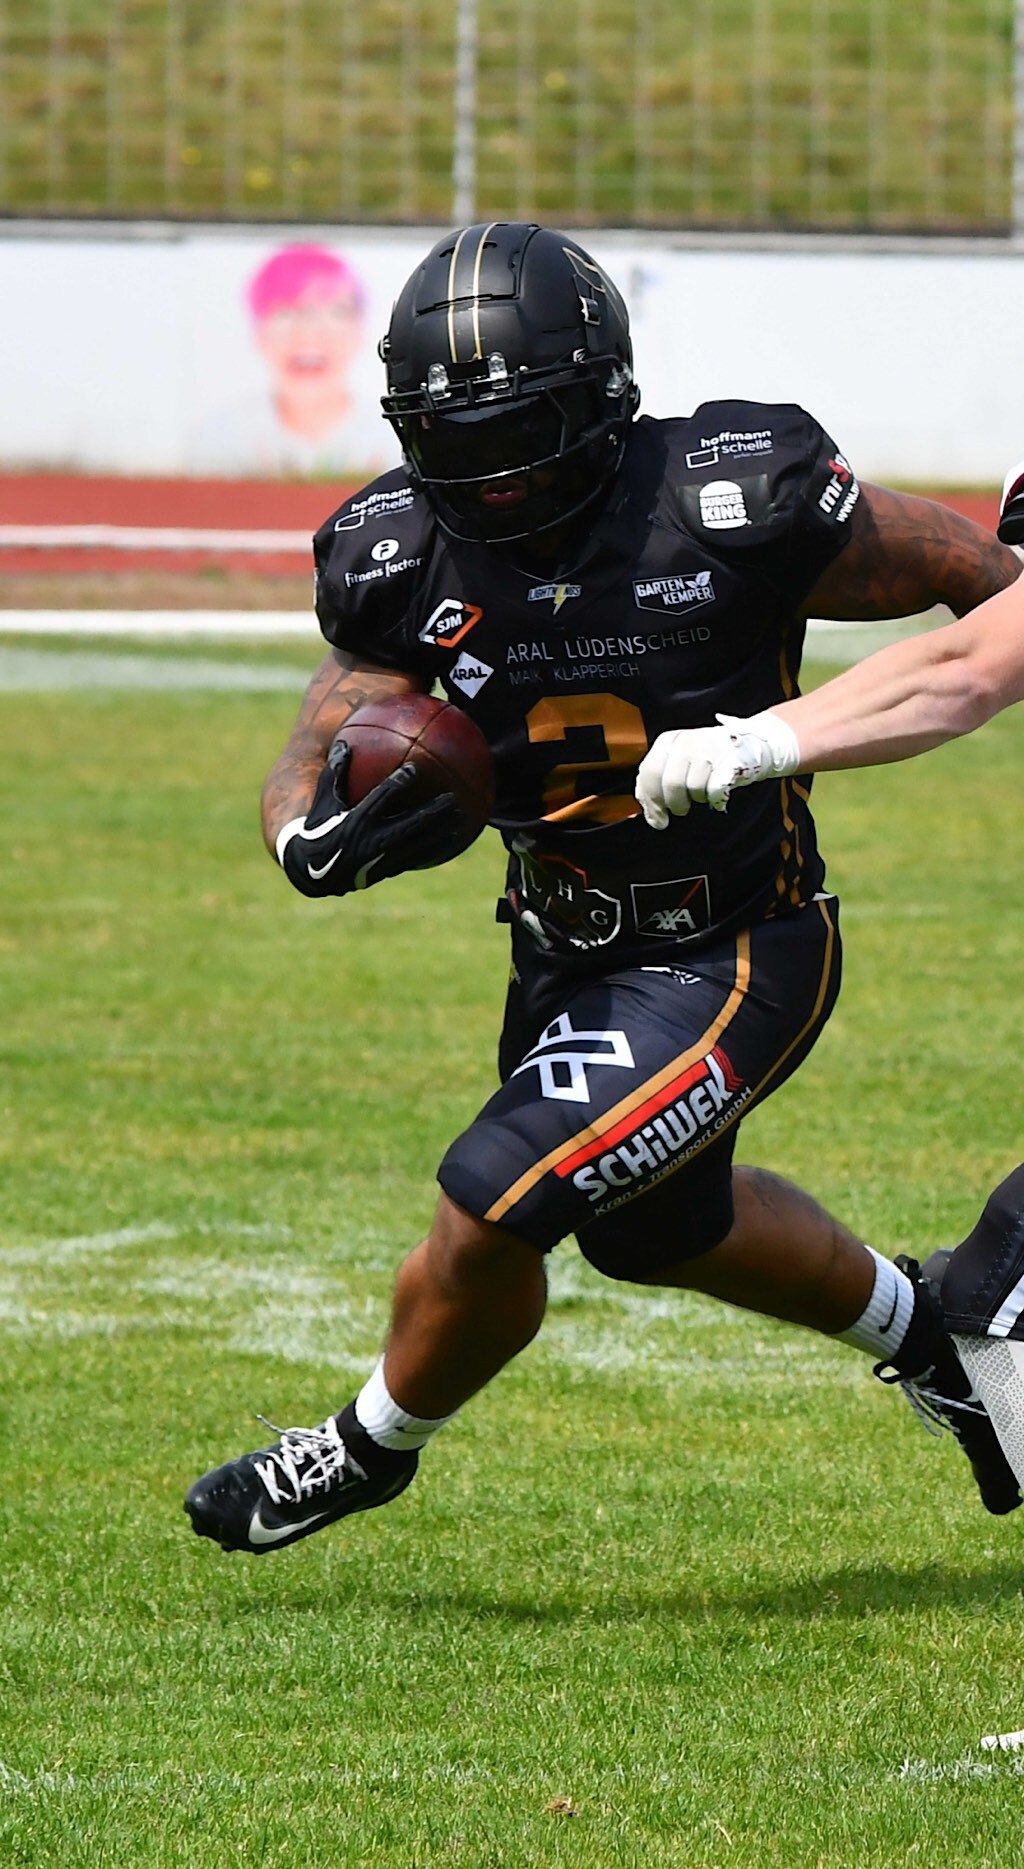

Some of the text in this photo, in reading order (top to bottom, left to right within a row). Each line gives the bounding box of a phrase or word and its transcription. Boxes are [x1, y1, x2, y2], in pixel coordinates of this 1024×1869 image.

[700, 430, 772, 448] hoffmann
[721, 439, 772, 454] schelle
[367, 496, 414, 516] schelle
[700, 493, 744, 508] BURGER
[701, 503, 747, 522] KING
[345, 558, 421, 588] fitness factor
[636, 578, 685, 597] GARTEN
[662, 586, 713, 606] KEMPER
[436, 613, 462, 633] SJM
[506, 627, 711, 664] ARAL LÜDENSCHEID
[452, 666, 488, 680] ARAL
[553, 663, 640, 681] KLAPPERICH
[646, 908, 697, 931] AXA
[714, 1086, 753, 1130] GmbH
